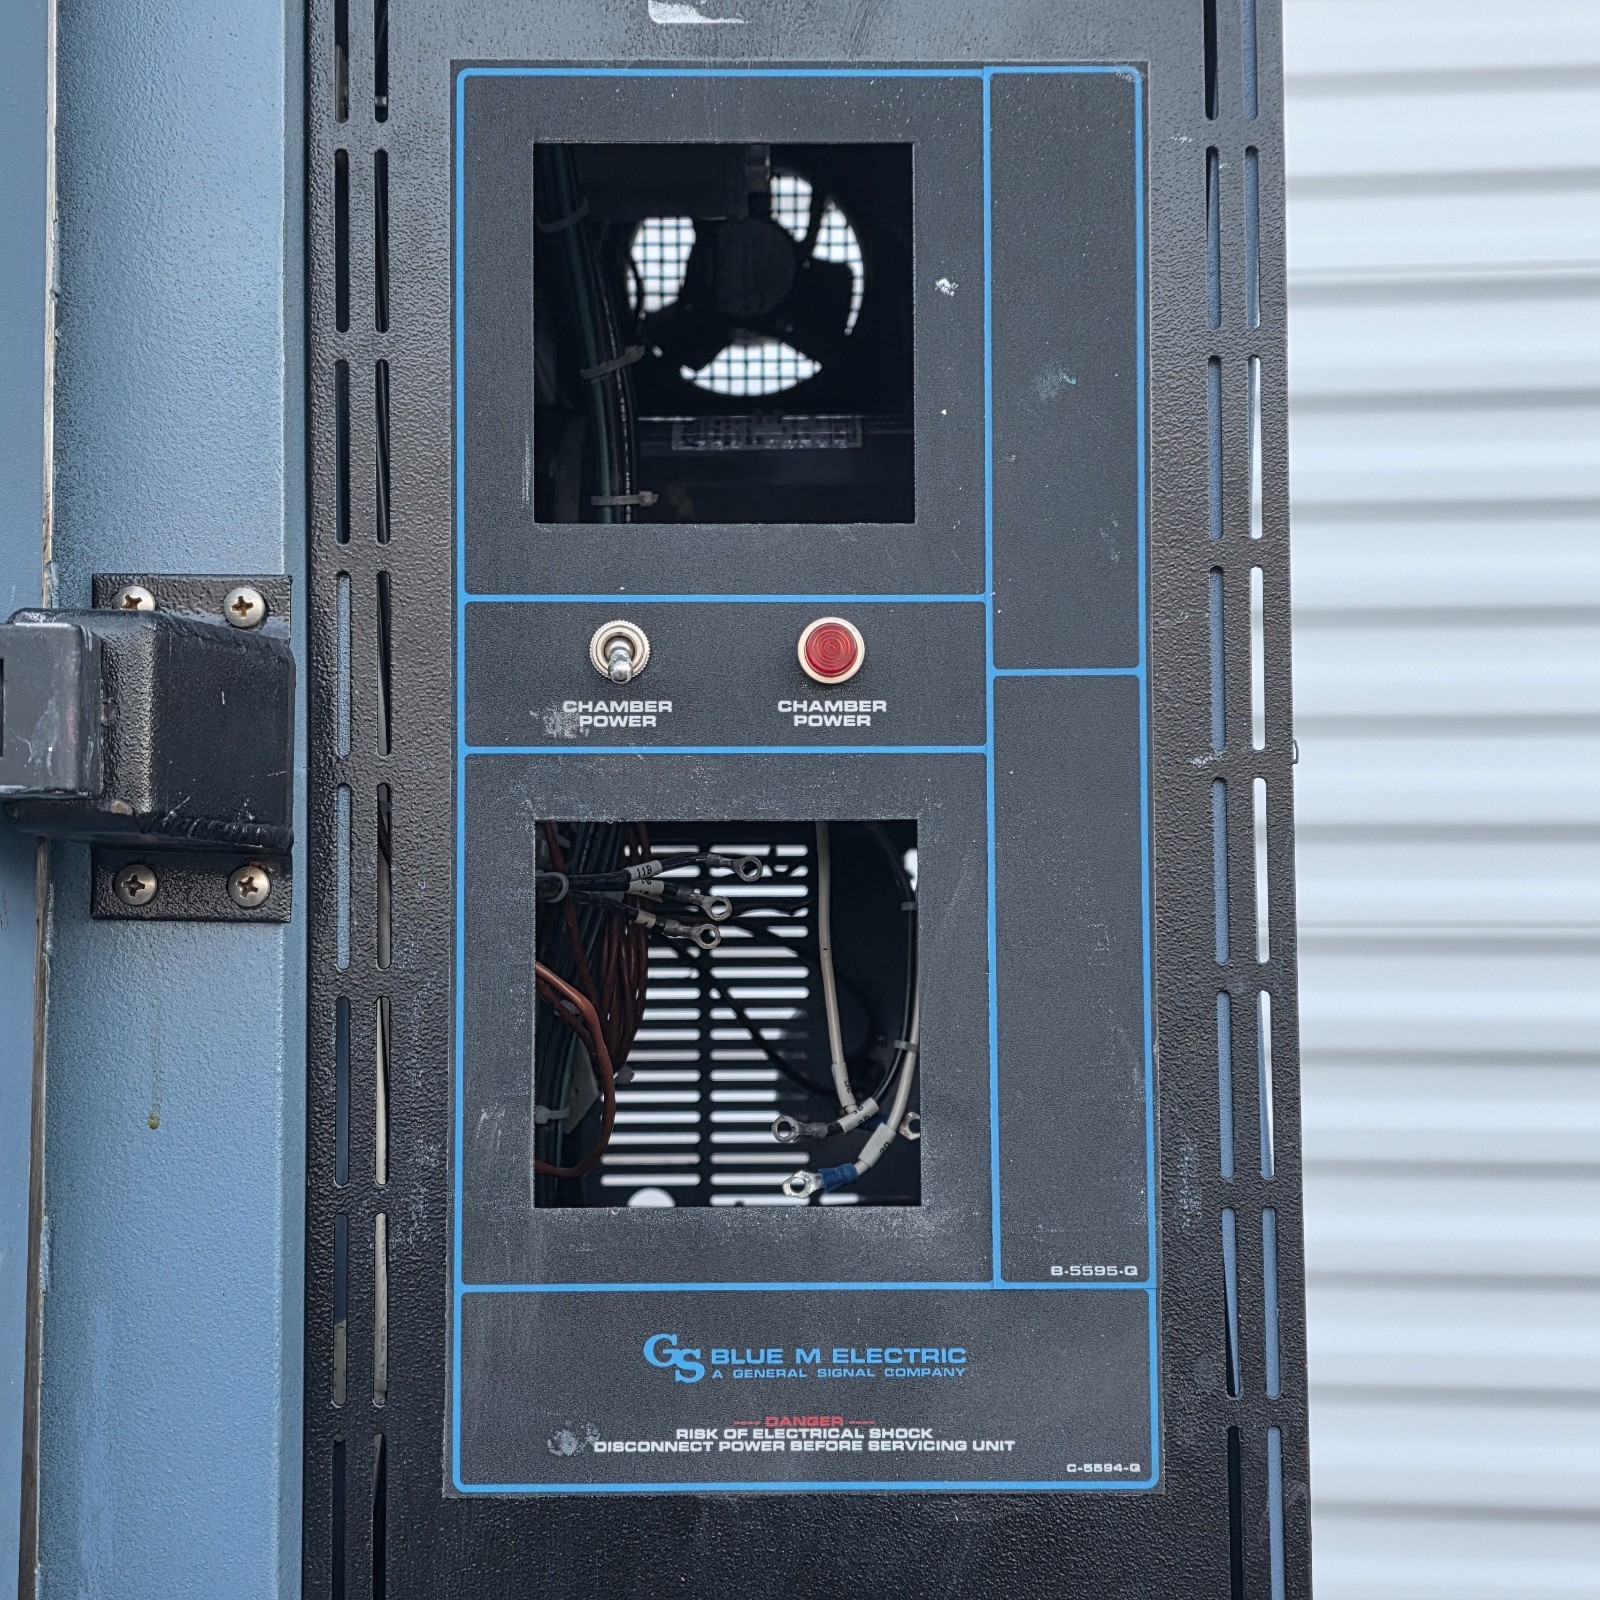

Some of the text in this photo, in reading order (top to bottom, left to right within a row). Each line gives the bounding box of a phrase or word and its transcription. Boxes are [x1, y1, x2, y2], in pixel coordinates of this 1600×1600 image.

[562, 700, 673, 713] CHAMBER
[777, 700, 887, 712] CHAMBER
[579, 715, 657, 728] POWER
[793, 715, 871, 727] POWER
[1050, 1265, 1139, 1276] B-5595-Q
[711, 1346, 967, 1365] BLUE M ELECTRIC
[712, 1366, 966, 1379] A GENERAL SIGNAL COMPANY
[765, 1415, 844, 1428] DANGER
[676, 1427, 933, 1440] RISK OF ELECTRICAL SHOCK
[593, 1440, 1016, 1453] DISCONNECT POWER BEFORE SERVICING UNIT
